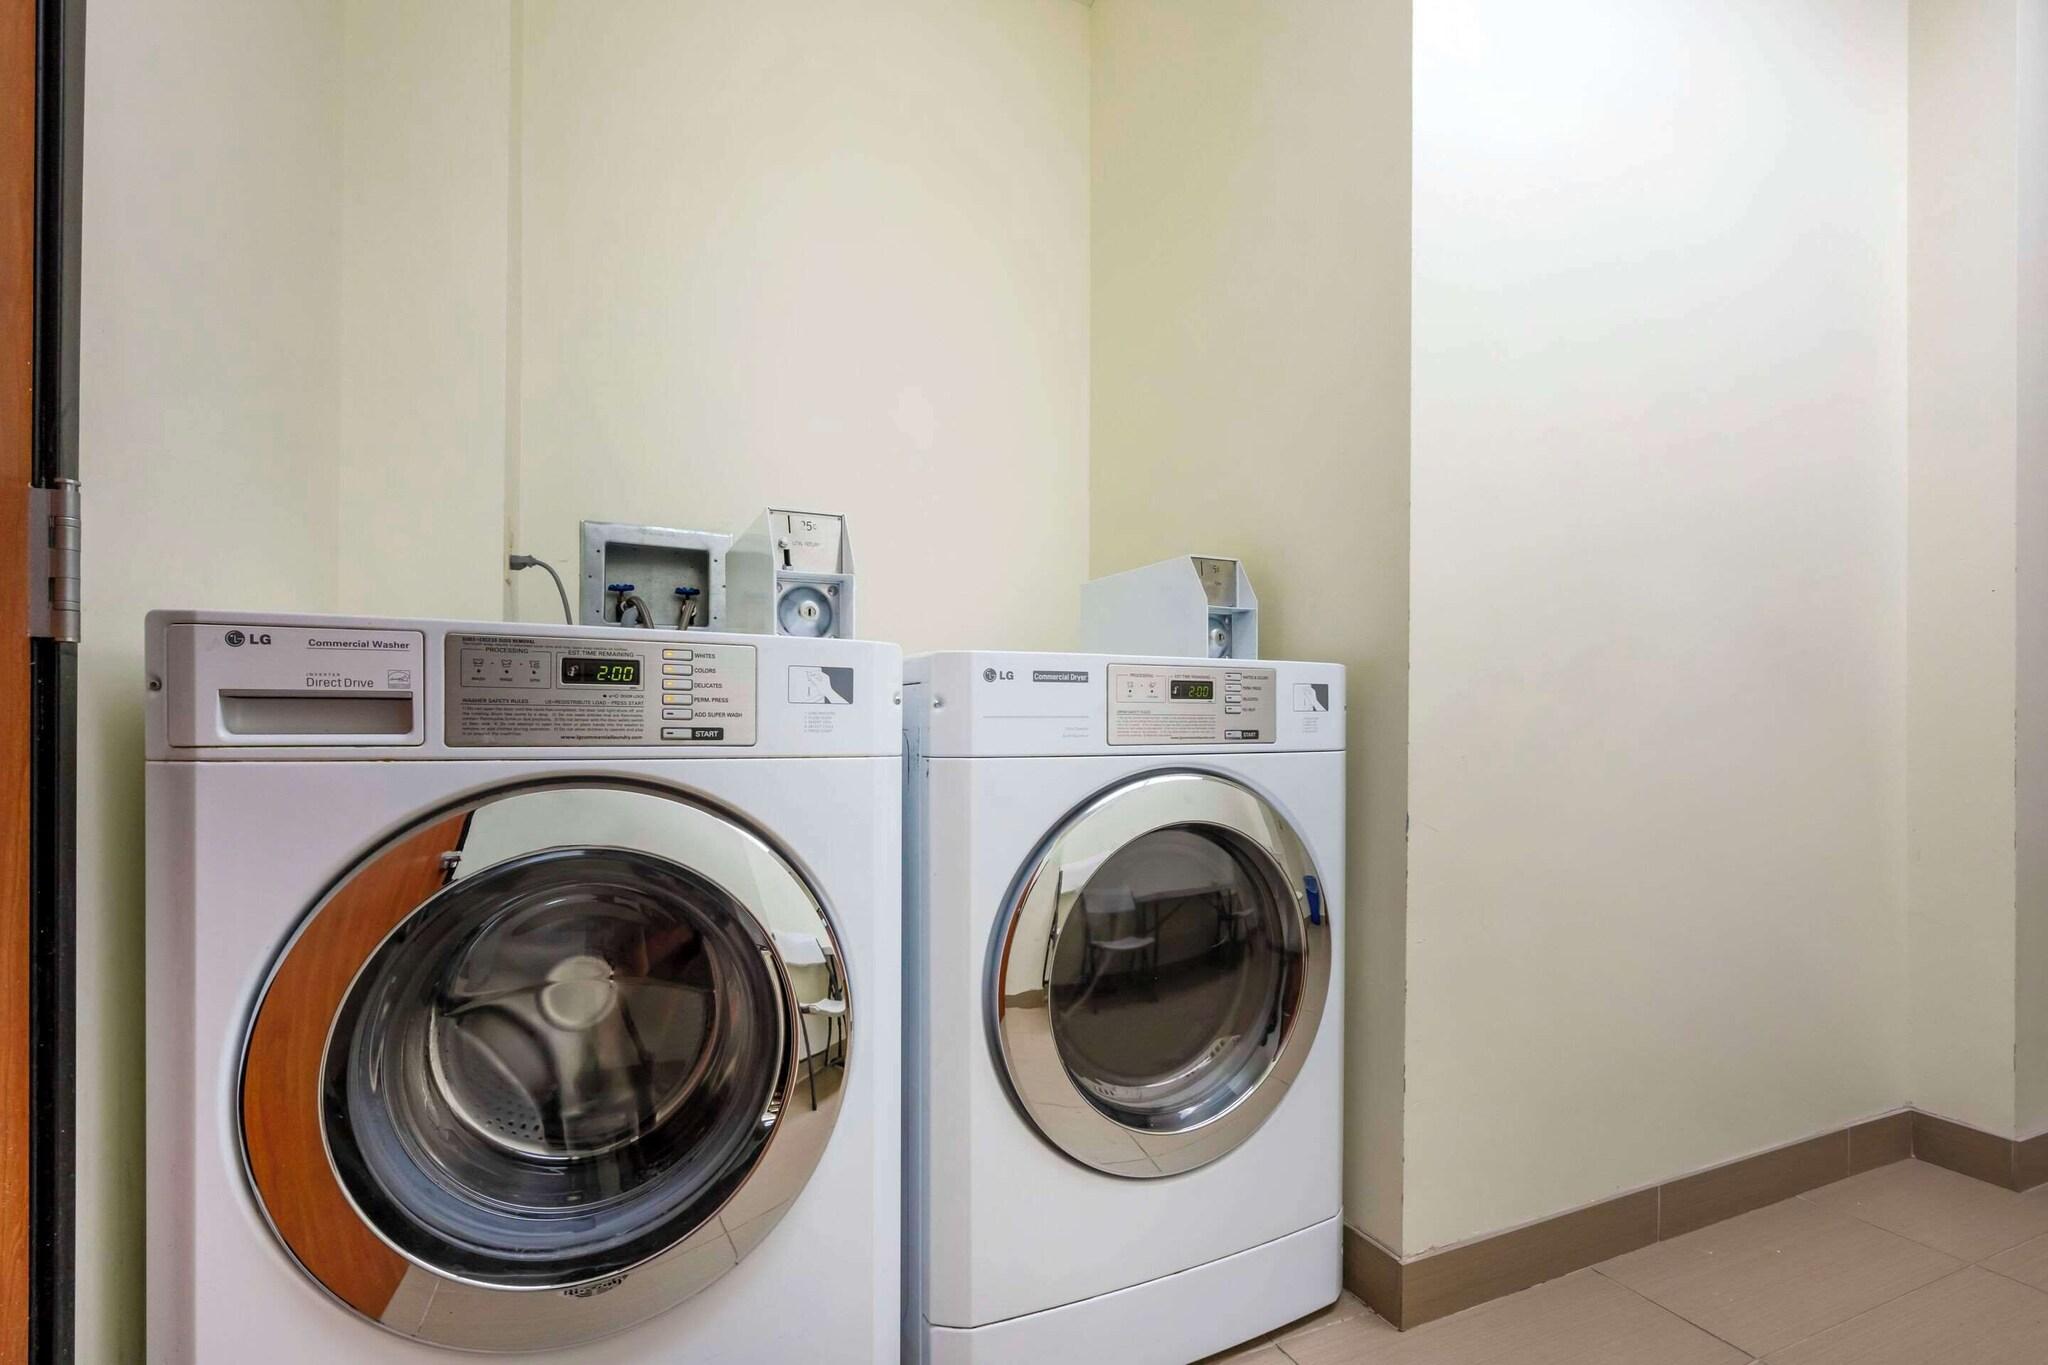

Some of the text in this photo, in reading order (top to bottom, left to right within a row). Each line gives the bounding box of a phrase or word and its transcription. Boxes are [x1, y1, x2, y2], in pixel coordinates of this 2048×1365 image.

[250, 634, 272, 646] LG
[308, 638, 410, 650] Commercial Washer
[485, 646, 529, 655] PROCESSING
[999, 670, 1015, 680] LG
[1033, 671, 1088, 683] Commercial Dryer
[306, 676, 375, 689] Direct Drive
[694, 711, 707, 719] ADD
[695, 730, 719, 738] START
